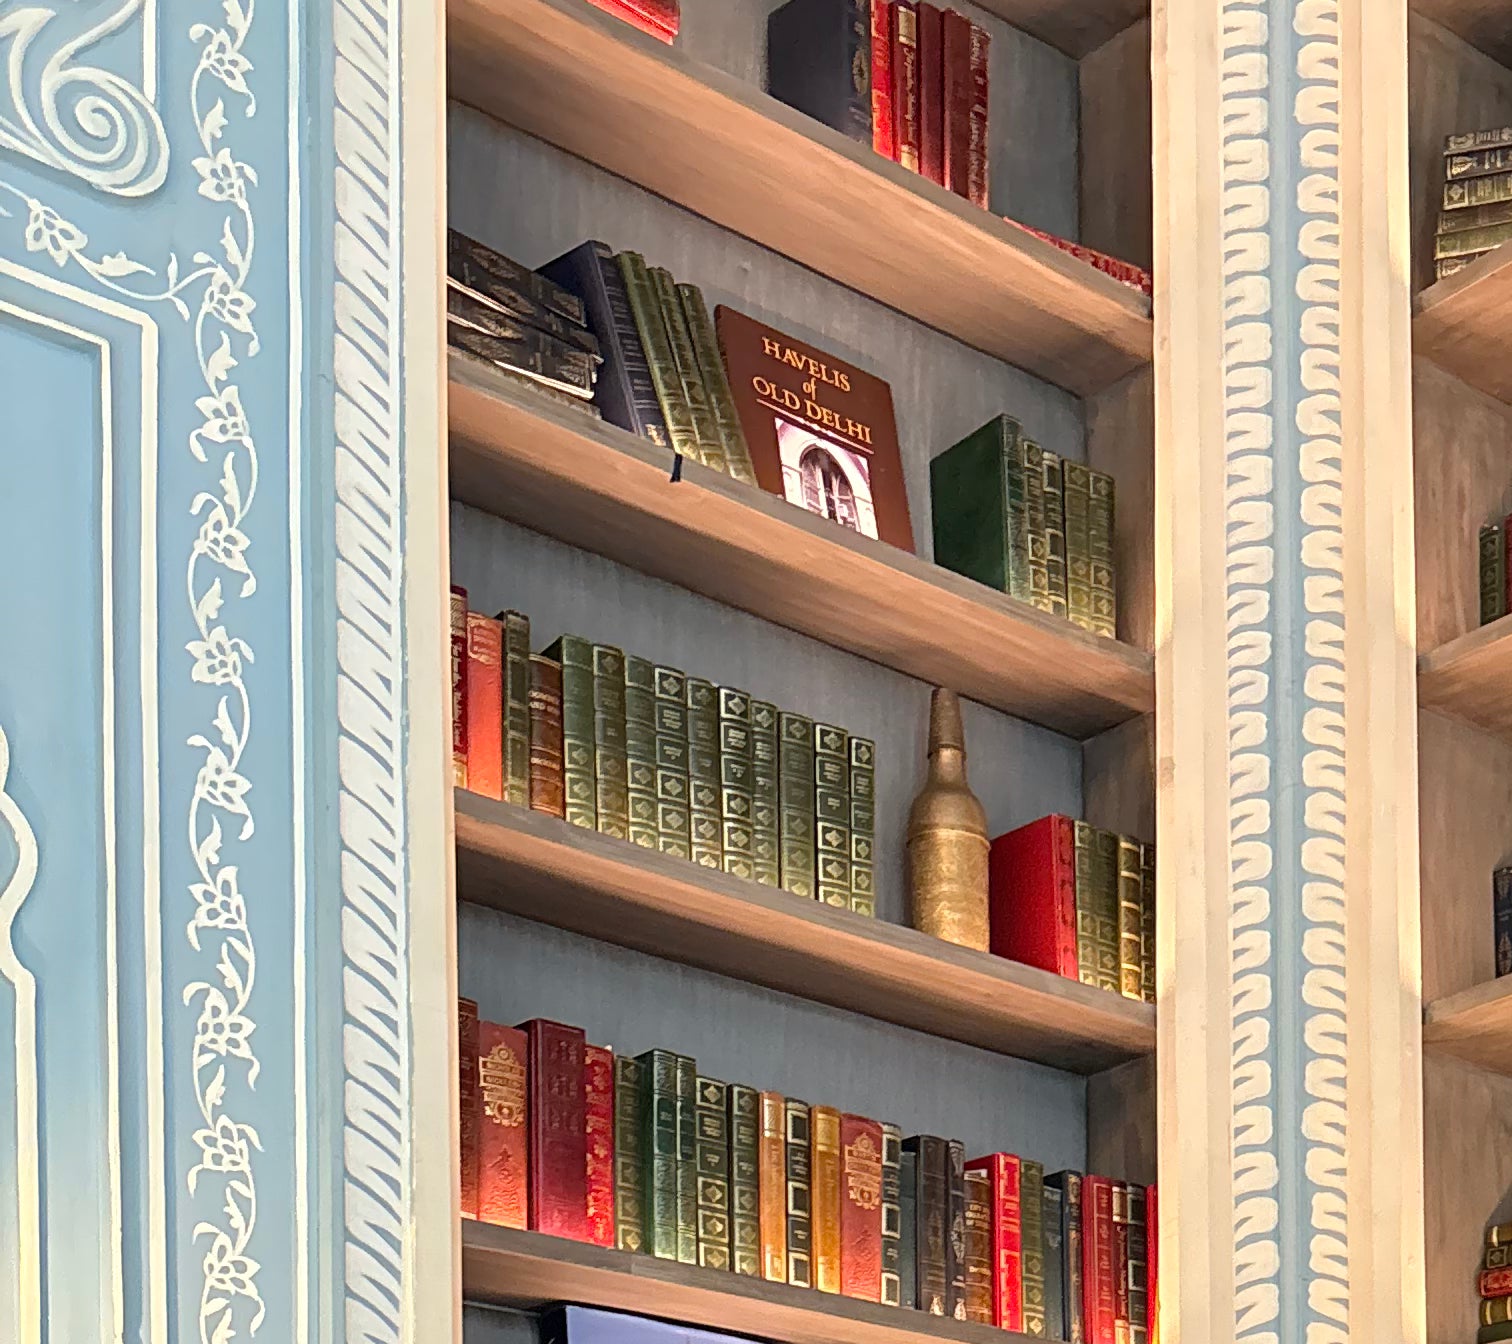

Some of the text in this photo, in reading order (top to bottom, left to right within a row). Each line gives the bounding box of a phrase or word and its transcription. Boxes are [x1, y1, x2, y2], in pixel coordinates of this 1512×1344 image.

[762, 336, 850, 392] HAVELIS
[802, 377, 817, 401] of
[753, 376, 873, 444] OLD DELHI
